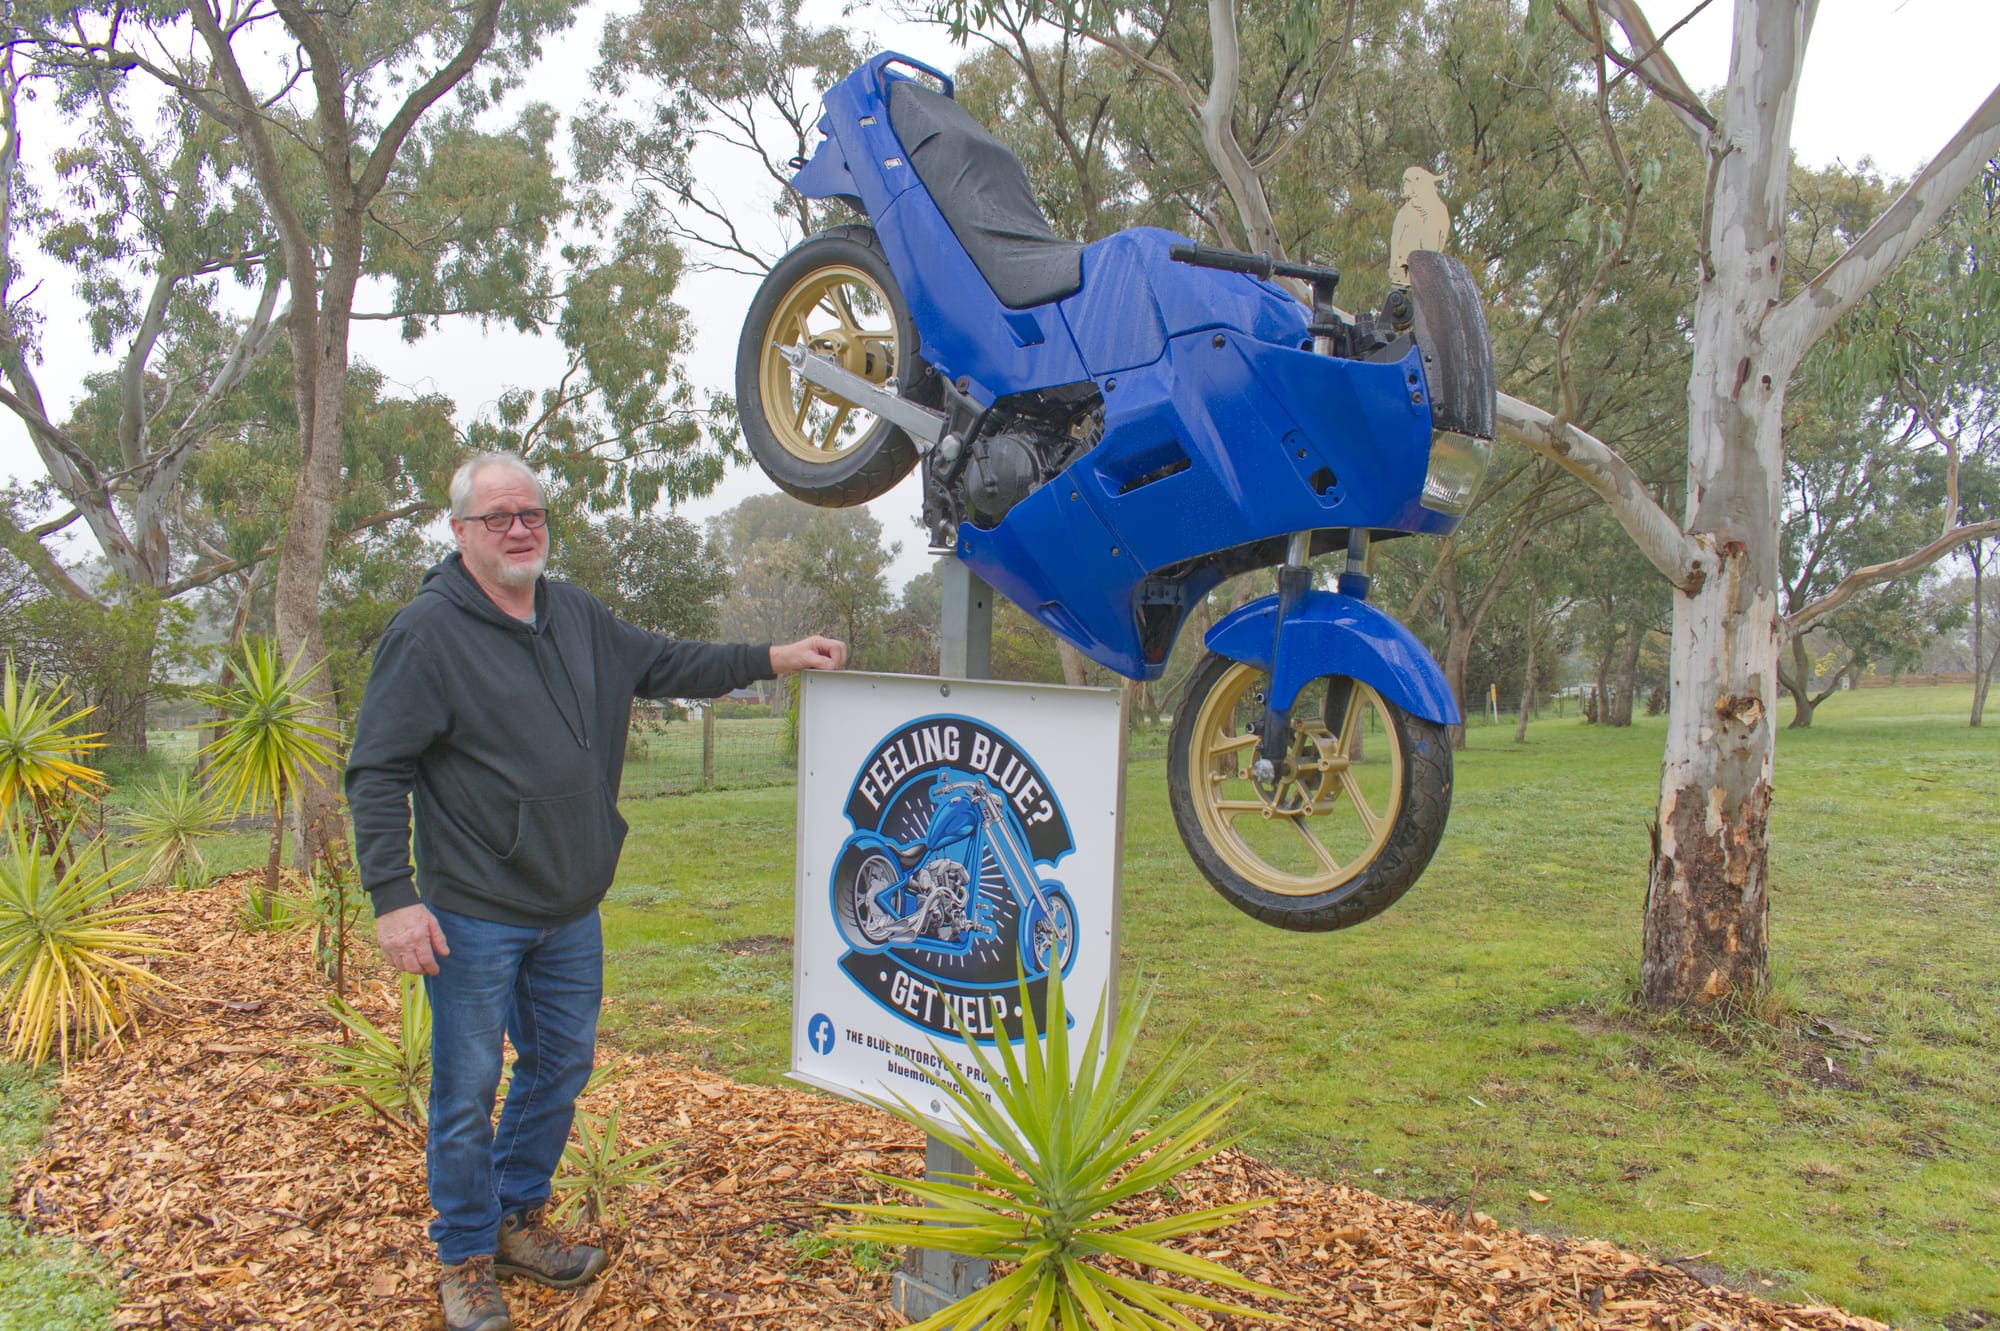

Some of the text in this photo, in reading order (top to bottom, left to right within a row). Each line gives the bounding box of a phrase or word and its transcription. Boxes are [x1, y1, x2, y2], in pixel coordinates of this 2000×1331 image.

[858, 725, 1054, 827] FEELING BLUE?
[891, 970, 1008, 1035] GET HELP
[846, 1029, 864, 1045] THE
[866, 1035, 891, 1053] BLUE
